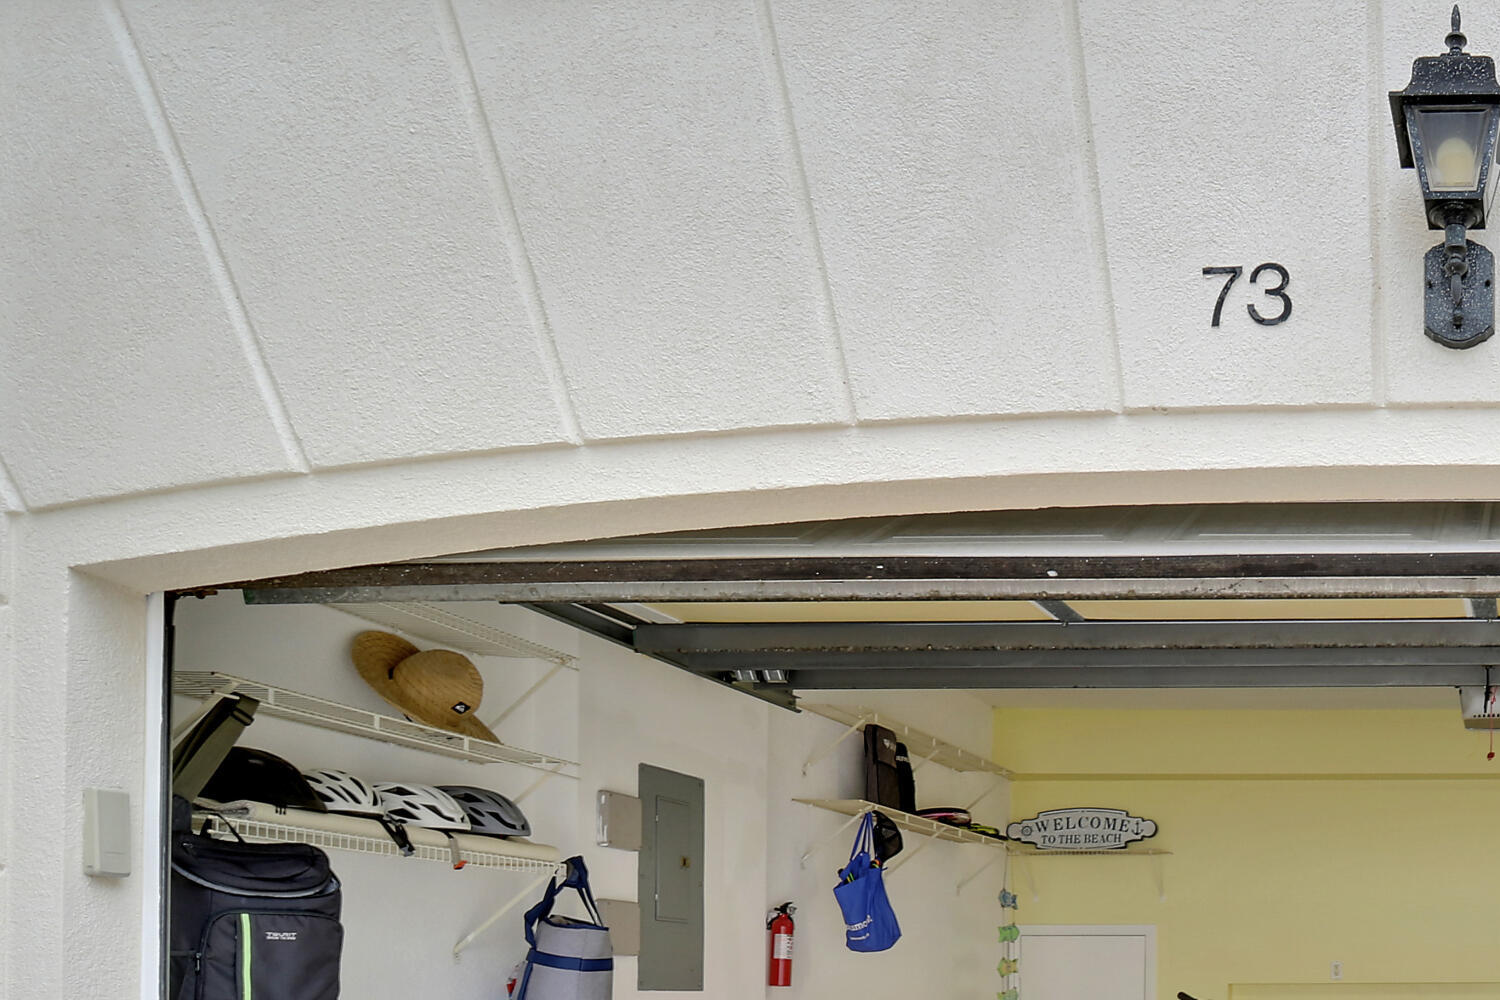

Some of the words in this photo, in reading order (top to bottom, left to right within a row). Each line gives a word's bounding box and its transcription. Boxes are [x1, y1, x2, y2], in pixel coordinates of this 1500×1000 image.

[1202, 262, 1292, 328] 73
[1034, 816, 1131, 833] WELCOME
[1041, 834, 1056, 845] TO
[1058, 834, 1081, 844] THE
[1083, 833, 1122, 844] BEACH
